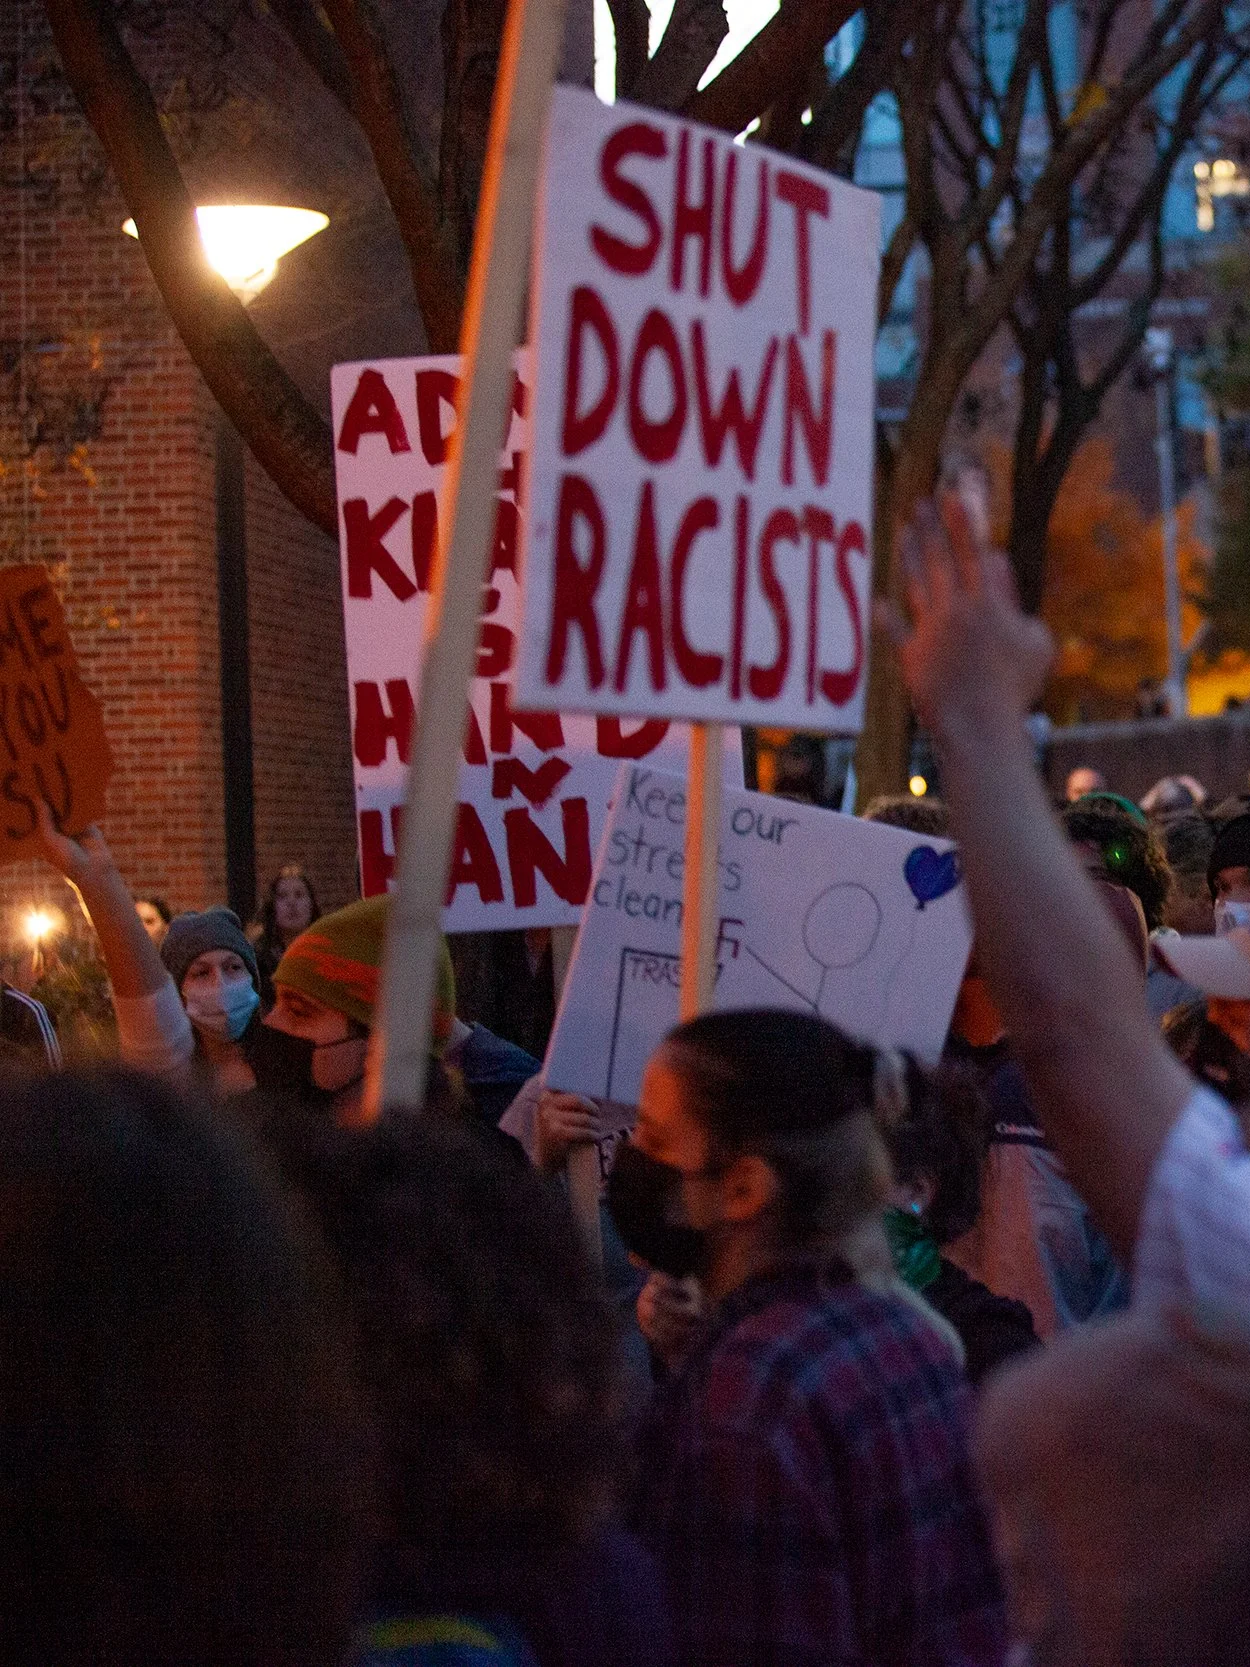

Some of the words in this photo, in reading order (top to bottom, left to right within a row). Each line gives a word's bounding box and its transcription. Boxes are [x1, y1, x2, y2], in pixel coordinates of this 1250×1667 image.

[589, 121, 833, 337] SHUT
[559, 283, 837, 488] DOWN
[542, 470, 867, 706] RACISTS
[360, 796, 593, 908] HAN
[627, 768, 687, 826] Kee
[731, 806, 801, 846] our
